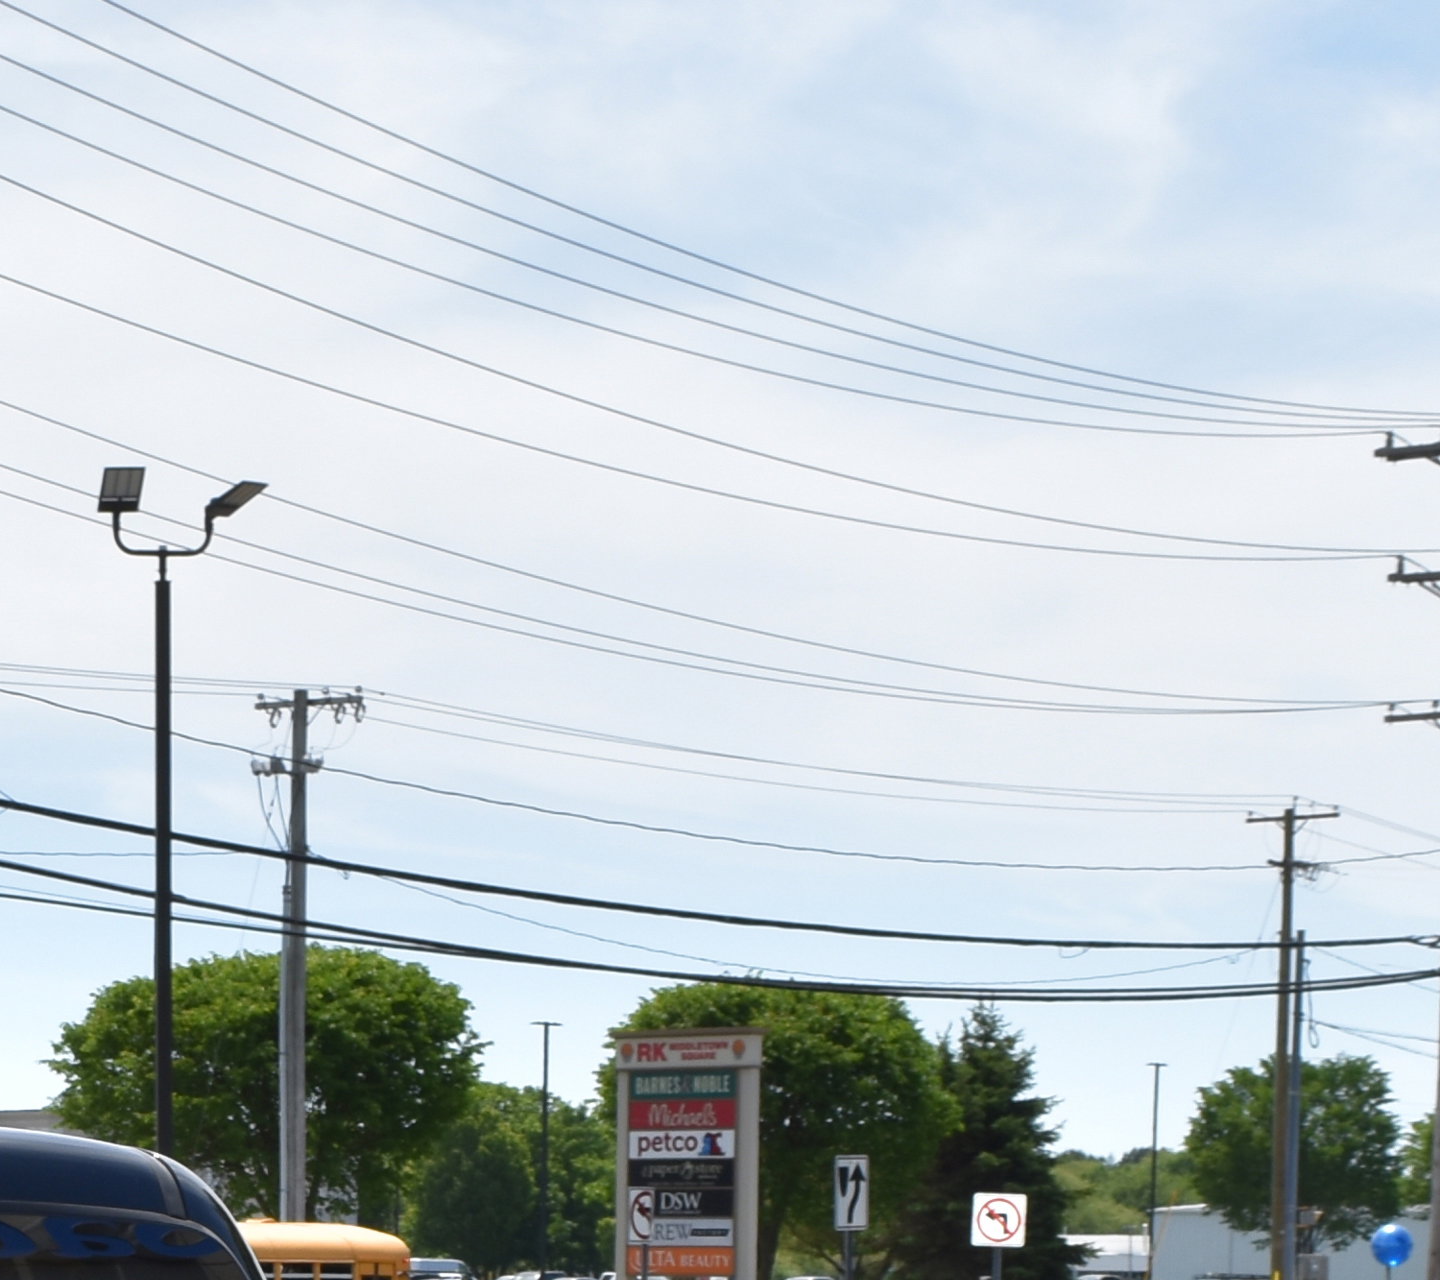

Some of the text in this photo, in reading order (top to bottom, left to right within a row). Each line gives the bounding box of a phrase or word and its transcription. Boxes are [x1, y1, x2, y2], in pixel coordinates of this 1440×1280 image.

[637, 1041, 668, 1062] RK
[635, 1076, 681, 1095] BARNES
[693, 1074, 730, 1093] NOBLE
[648, 1102, 718, 1127] Michaels
[637, 1133, 698, 1156] petco
[660, 1191, 702, 1210] DSW
[680, 1254, 730, 1268] BEAUTY
